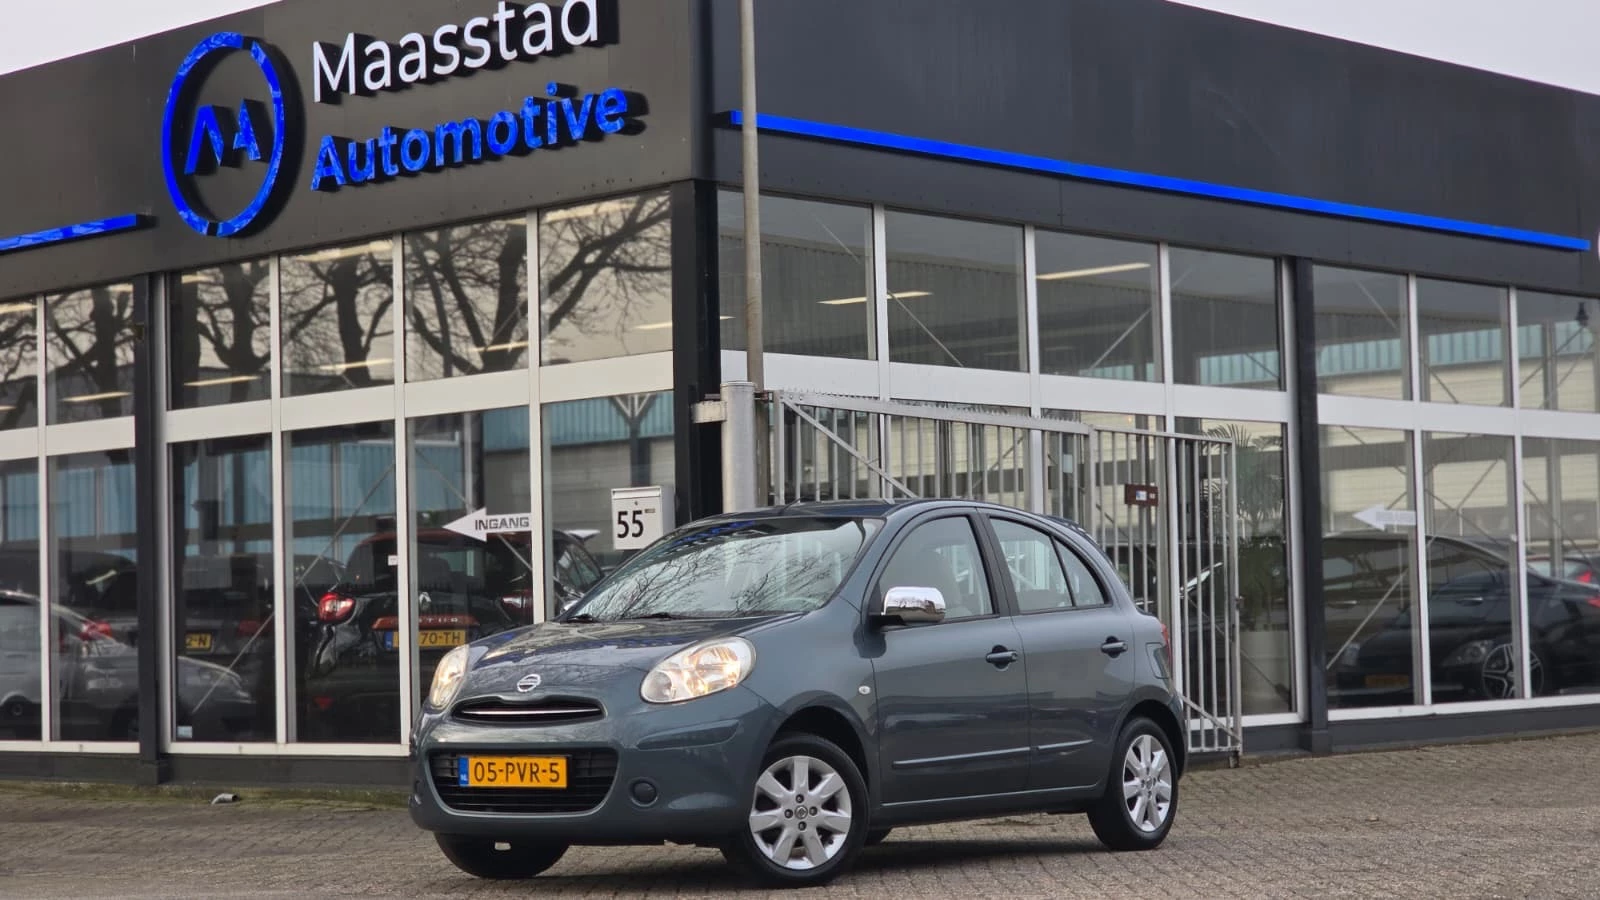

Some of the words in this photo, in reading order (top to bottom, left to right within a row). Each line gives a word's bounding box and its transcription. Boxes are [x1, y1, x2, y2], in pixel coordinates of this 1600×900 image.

[313, 0, 598, 102] Maasstad
[310, 81, 628, 191] Automotive
[475, 517, 530, 531] INGANG
[617, 510, 644, 539] 55
[420, 632, 462, 645] 70-TH
[473, 761, 560, 783] 05-PVR-5
